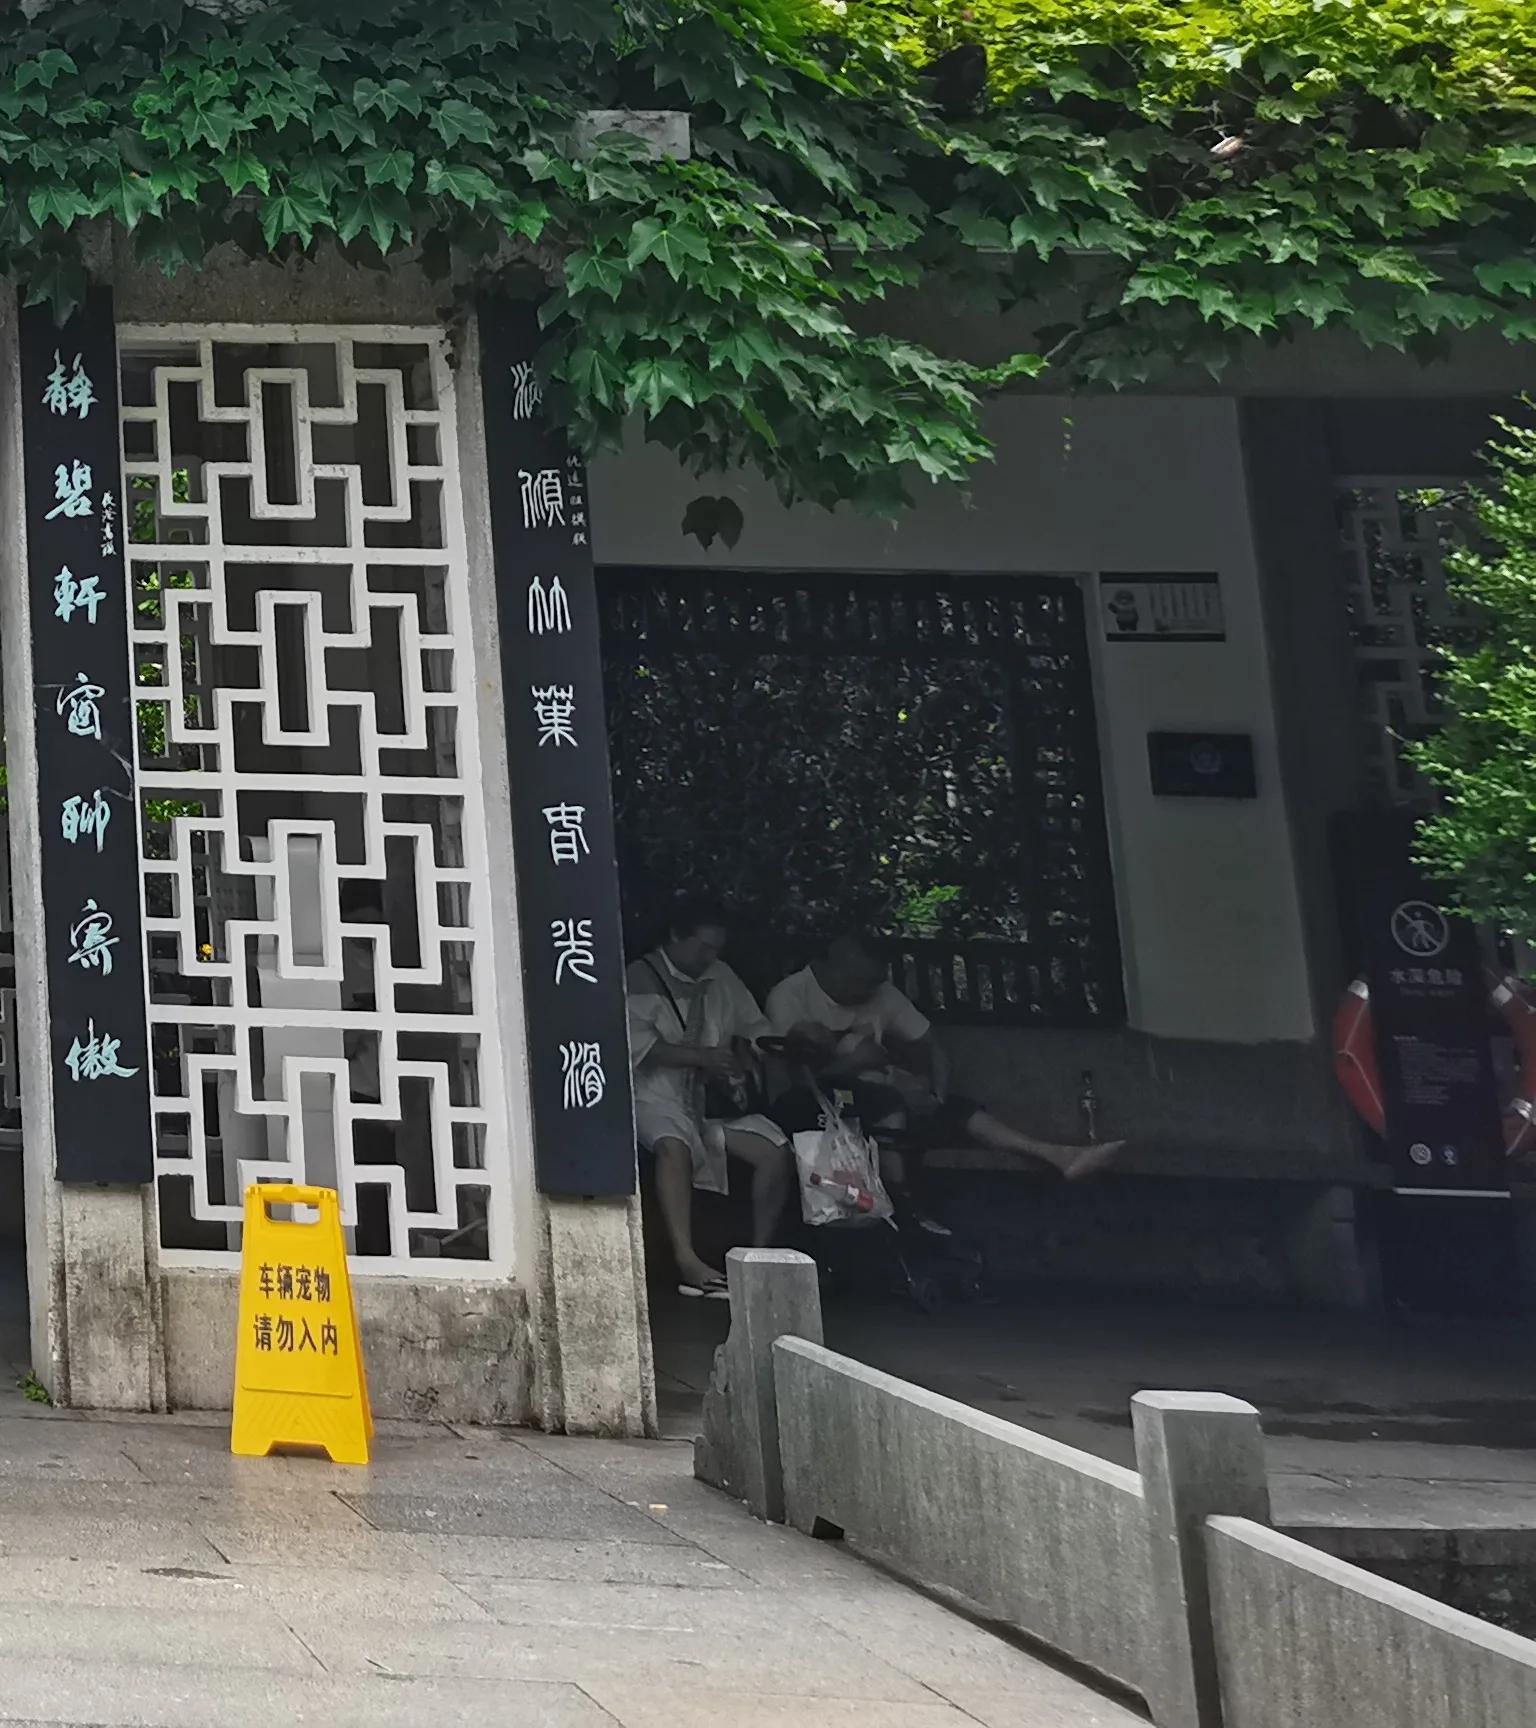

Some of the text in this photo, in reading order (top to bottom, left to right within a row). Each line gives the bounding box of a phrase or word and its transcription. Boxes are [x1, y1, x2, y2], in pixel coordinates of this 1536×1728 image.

[257, 1261, 331, 1303] 车辆宠物
[252, 1312, 338, 1356] 请勿入内
